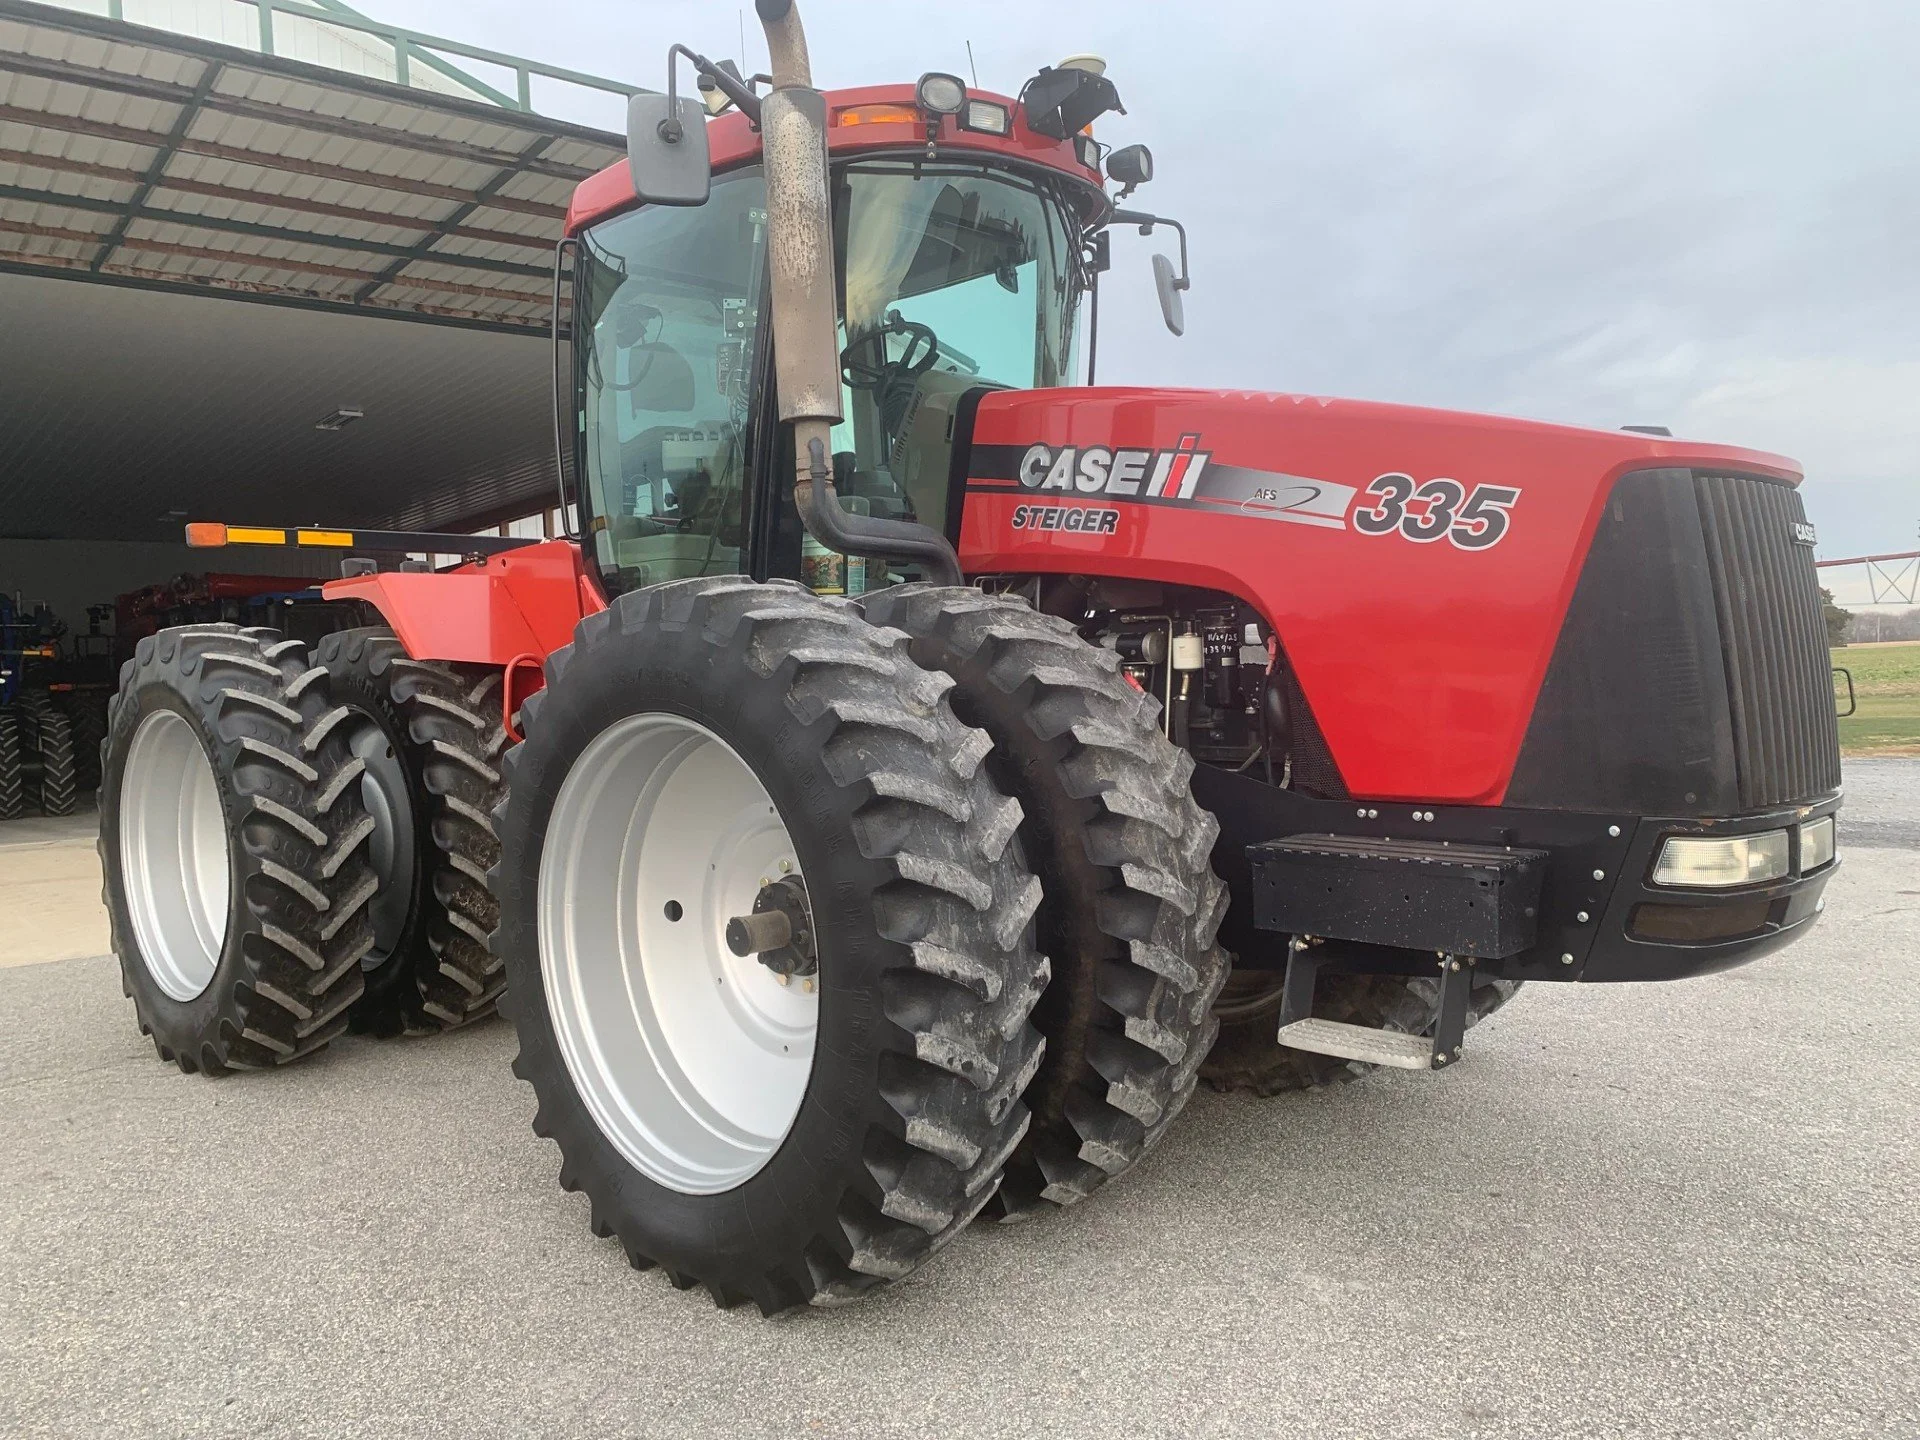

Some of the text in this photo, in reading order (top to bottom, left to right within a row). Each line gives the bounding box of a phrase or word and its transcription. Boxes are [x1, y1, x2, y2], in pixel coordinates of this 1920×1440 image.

[1020, 444, 1150, 496] CASE
[1254, 487, 1277, 500] AFS
[1353, 472, 1522, 551] 335
[1012, 505, 1120, 535] STEIGER
